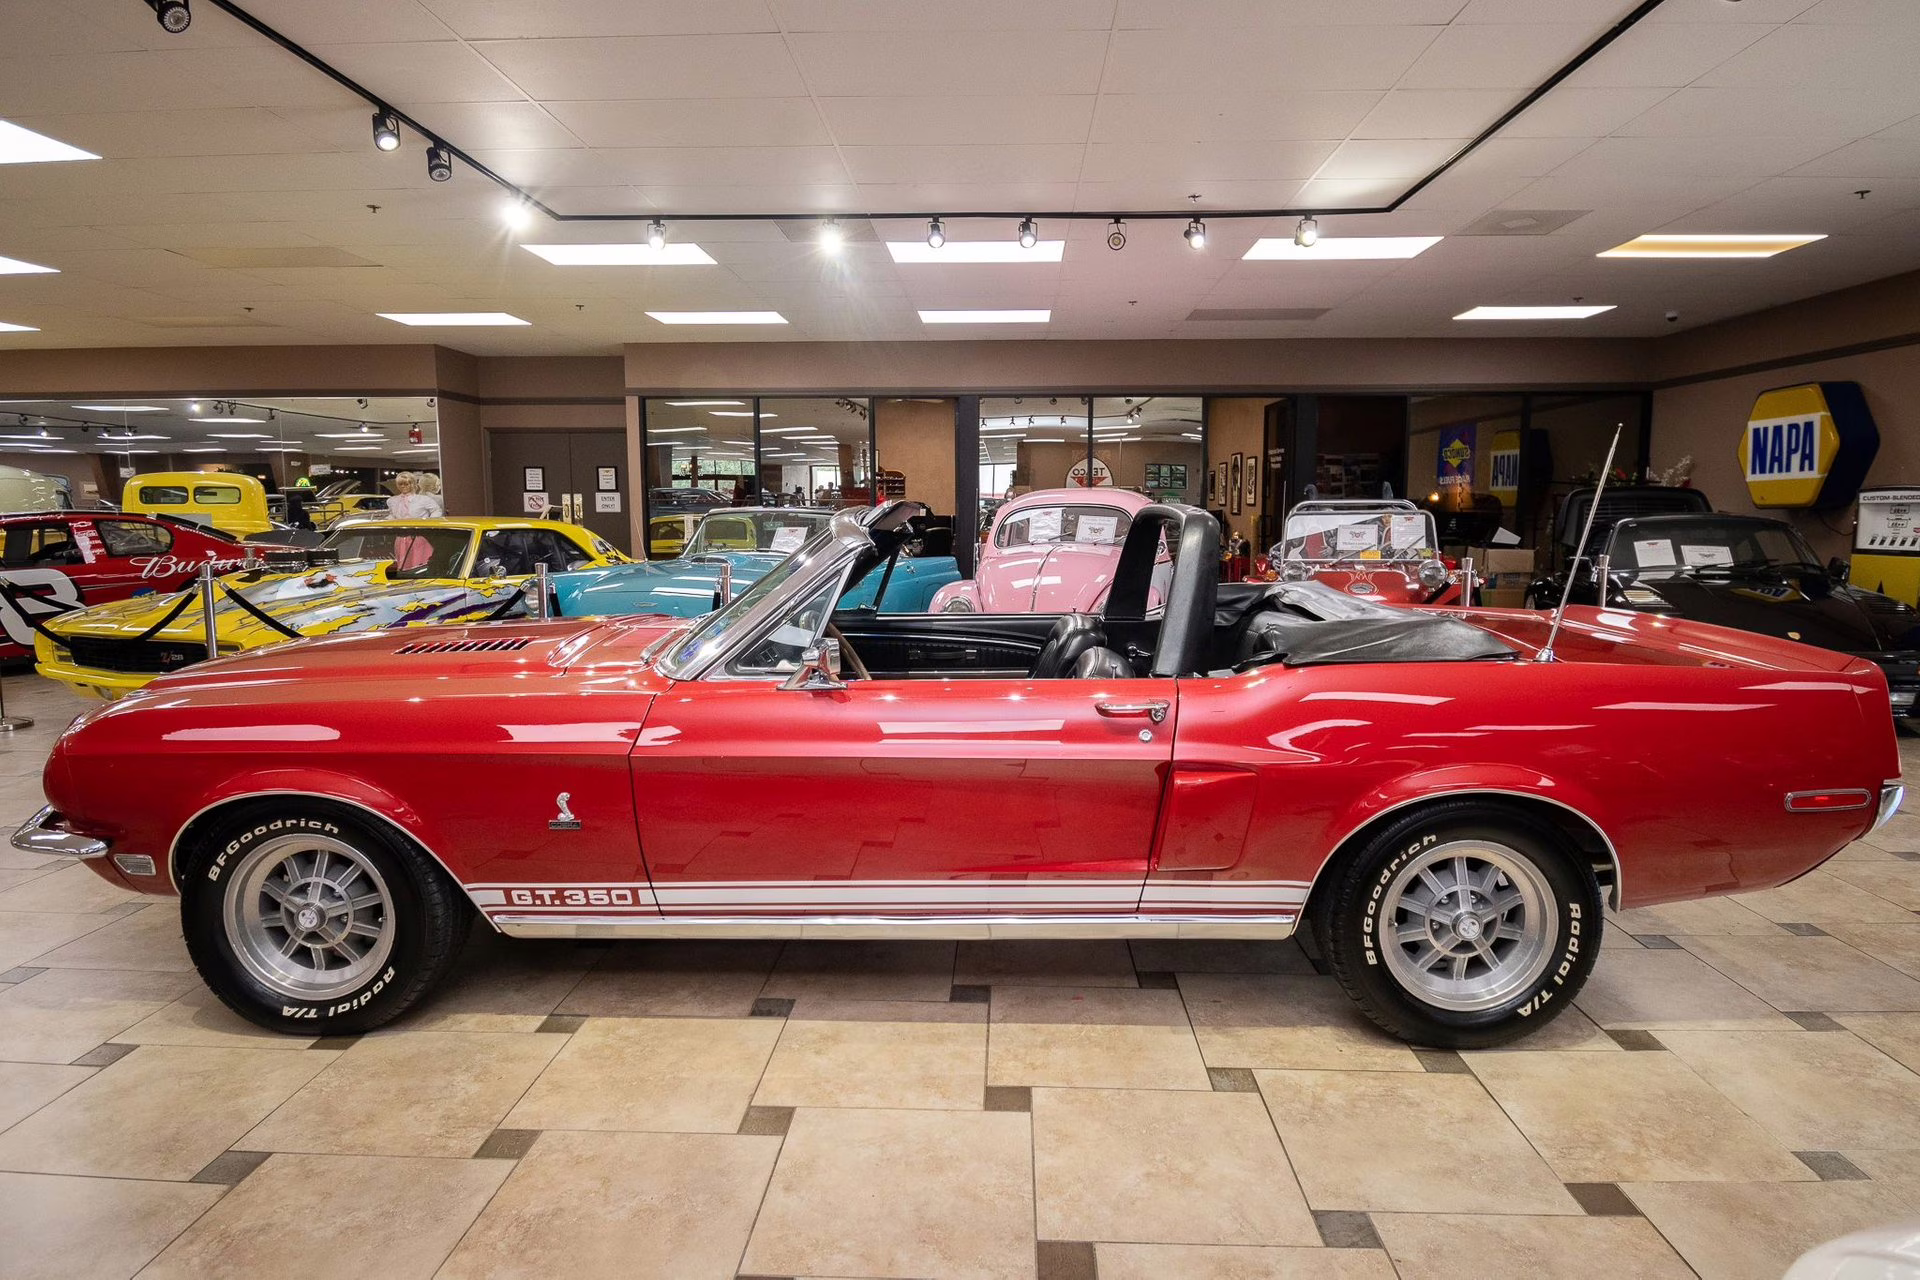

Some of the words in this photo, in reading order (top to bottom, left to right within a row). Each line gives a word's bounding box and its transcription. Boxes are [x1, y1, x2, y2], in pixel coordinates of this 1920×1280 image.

[1751, 421, 1814, 475] NAPA
[207, 818, 339, 882] BFGoodrich
[510, 889, 633, 905] G.T.350
[1363, 834, 1437, 965] BFGoodrich
[1553, 902, 1582, 985] Radial
[281, 1005, 318, 1018] T/A
[328, 966, 396, 1017] Radial
[1517, 991, 1553, 1017] T/A
